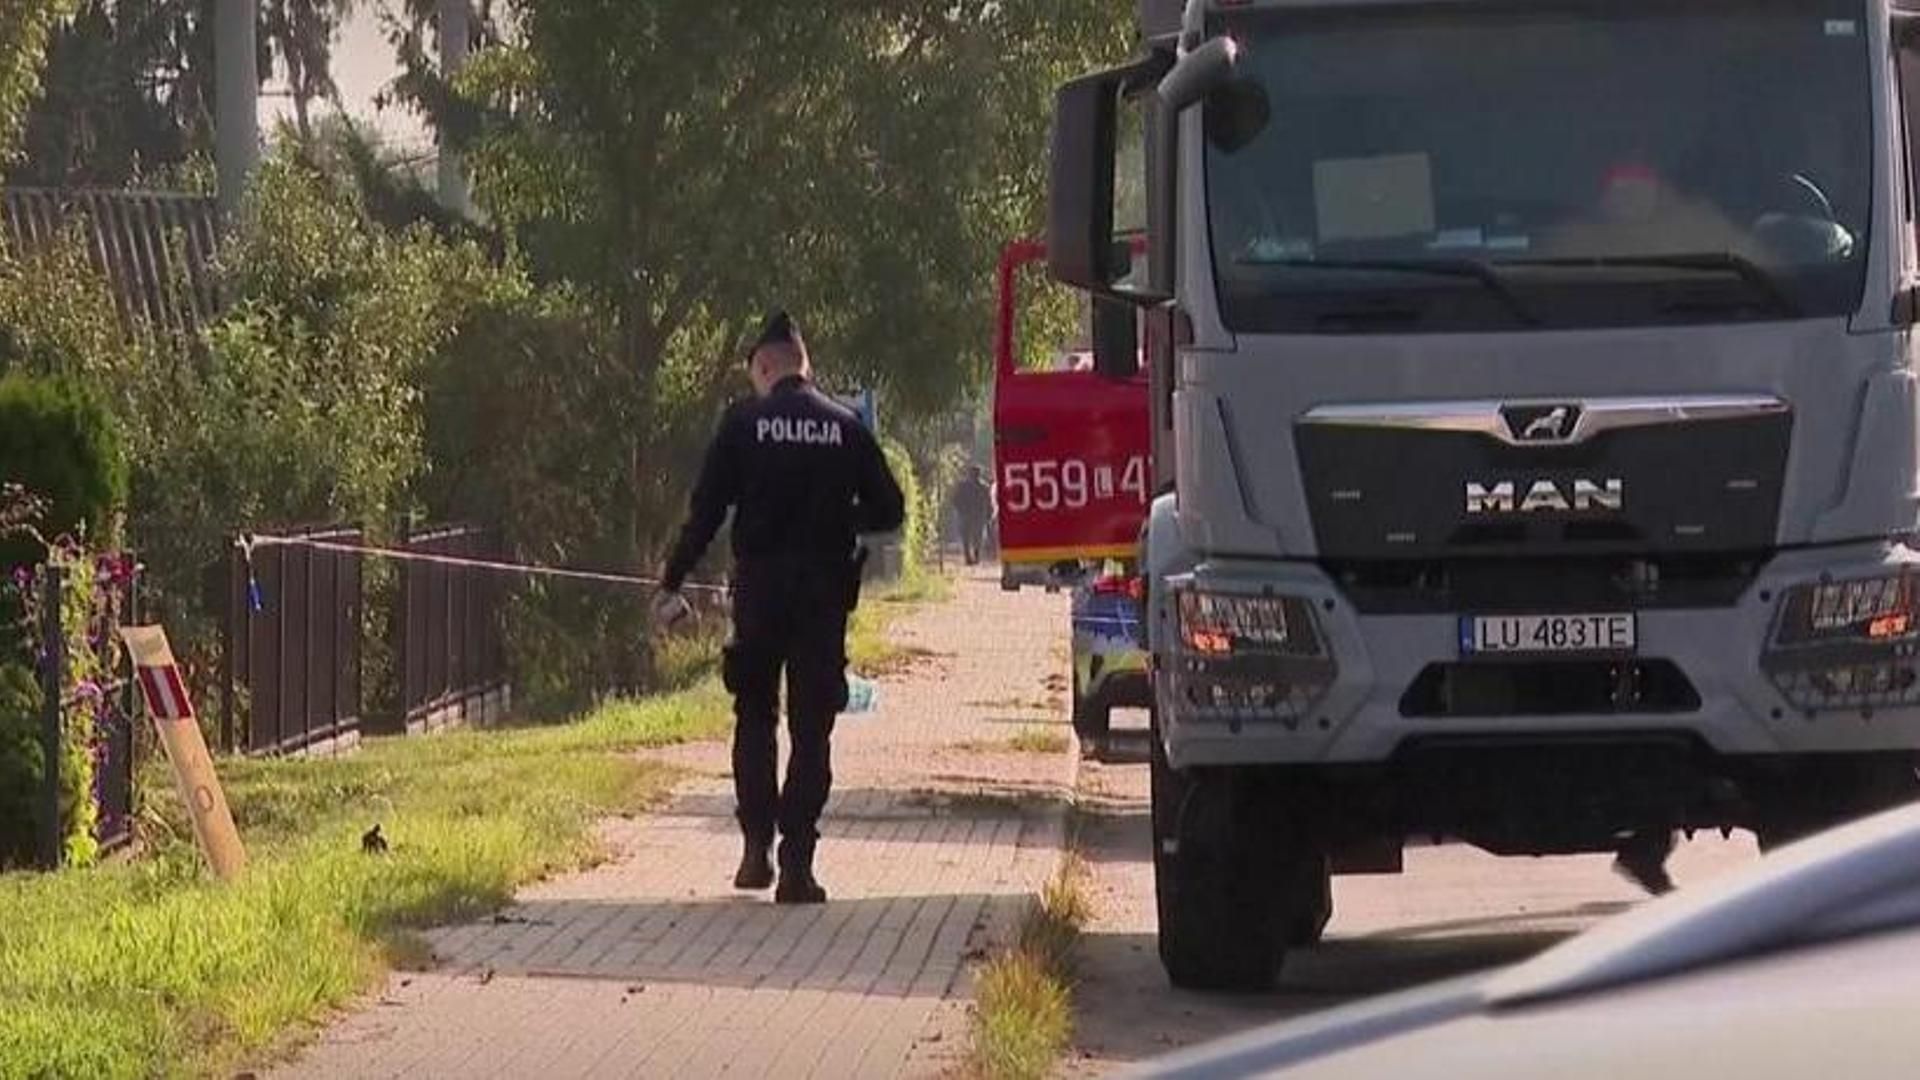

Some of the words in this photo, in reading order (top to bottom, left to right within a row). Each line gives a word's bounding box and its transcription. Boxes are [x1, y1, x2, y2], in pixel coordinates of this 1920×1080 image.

[757, 417, 842, 445] POLICJA
[1005, 460, 1088, 512] 559
[1121, 456, 1154, 505] 4
[1466, 479, 1621, 512] MAN
[1482, 620, 1520, 649] LU
[1532, 617, 1627, 646] 483TE
